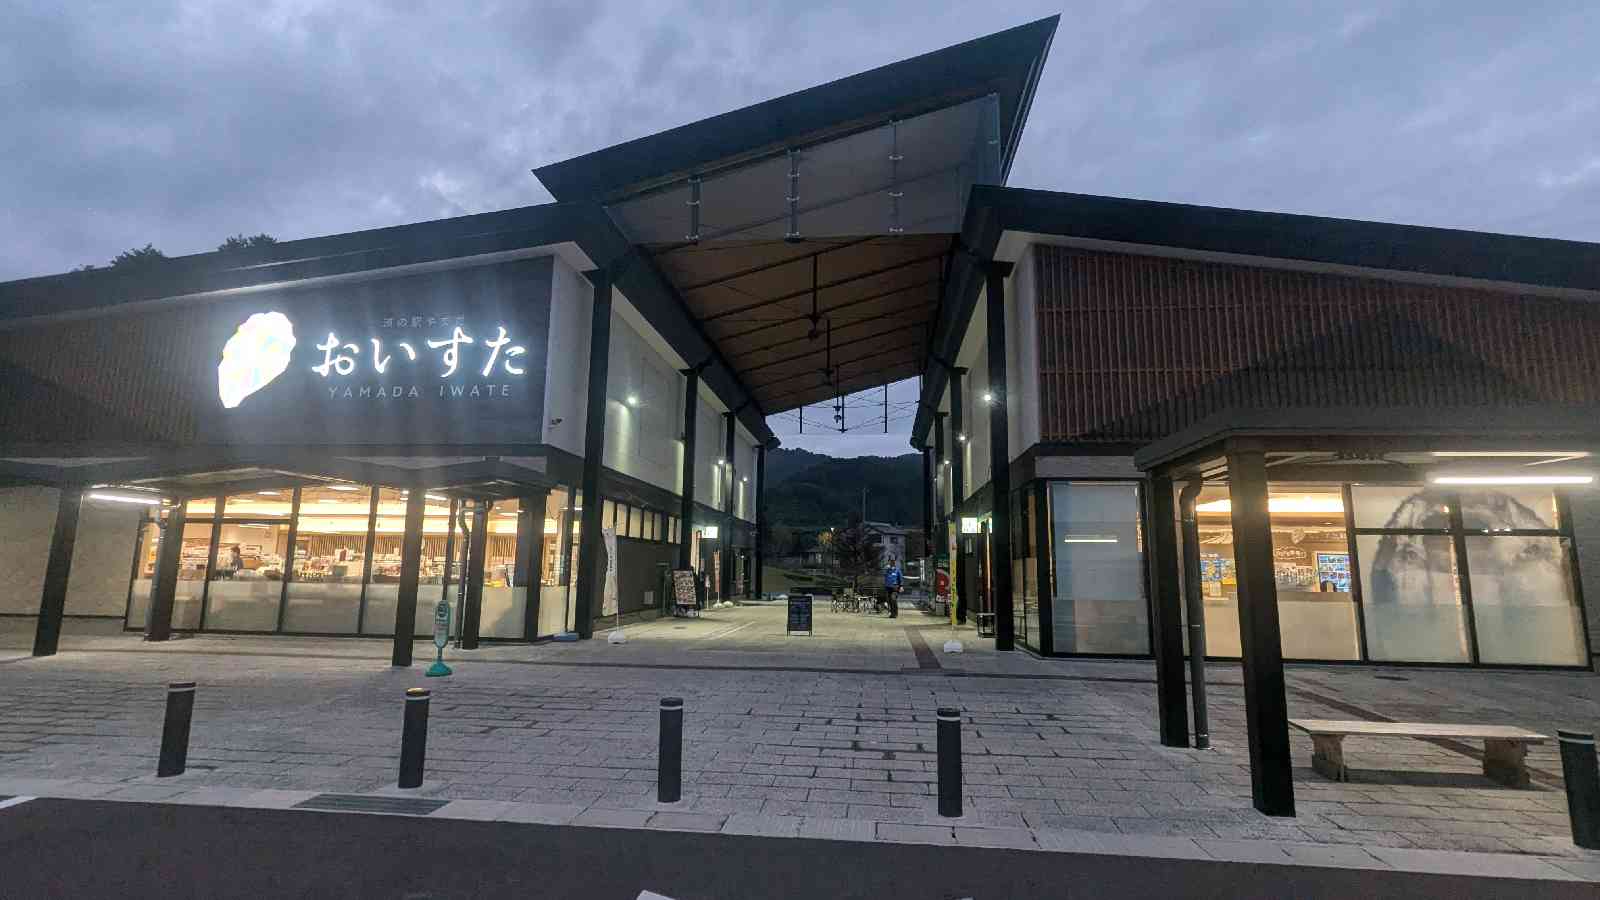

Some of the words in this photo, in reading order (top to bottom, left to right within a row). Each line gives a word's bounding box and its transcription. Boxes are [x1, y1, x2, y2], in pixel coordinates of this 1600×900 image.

[312, 326, 526, 378] おいすた
[328, 385, 419, 398] YAMADA
[439, 384, 512, 397] IWATE
